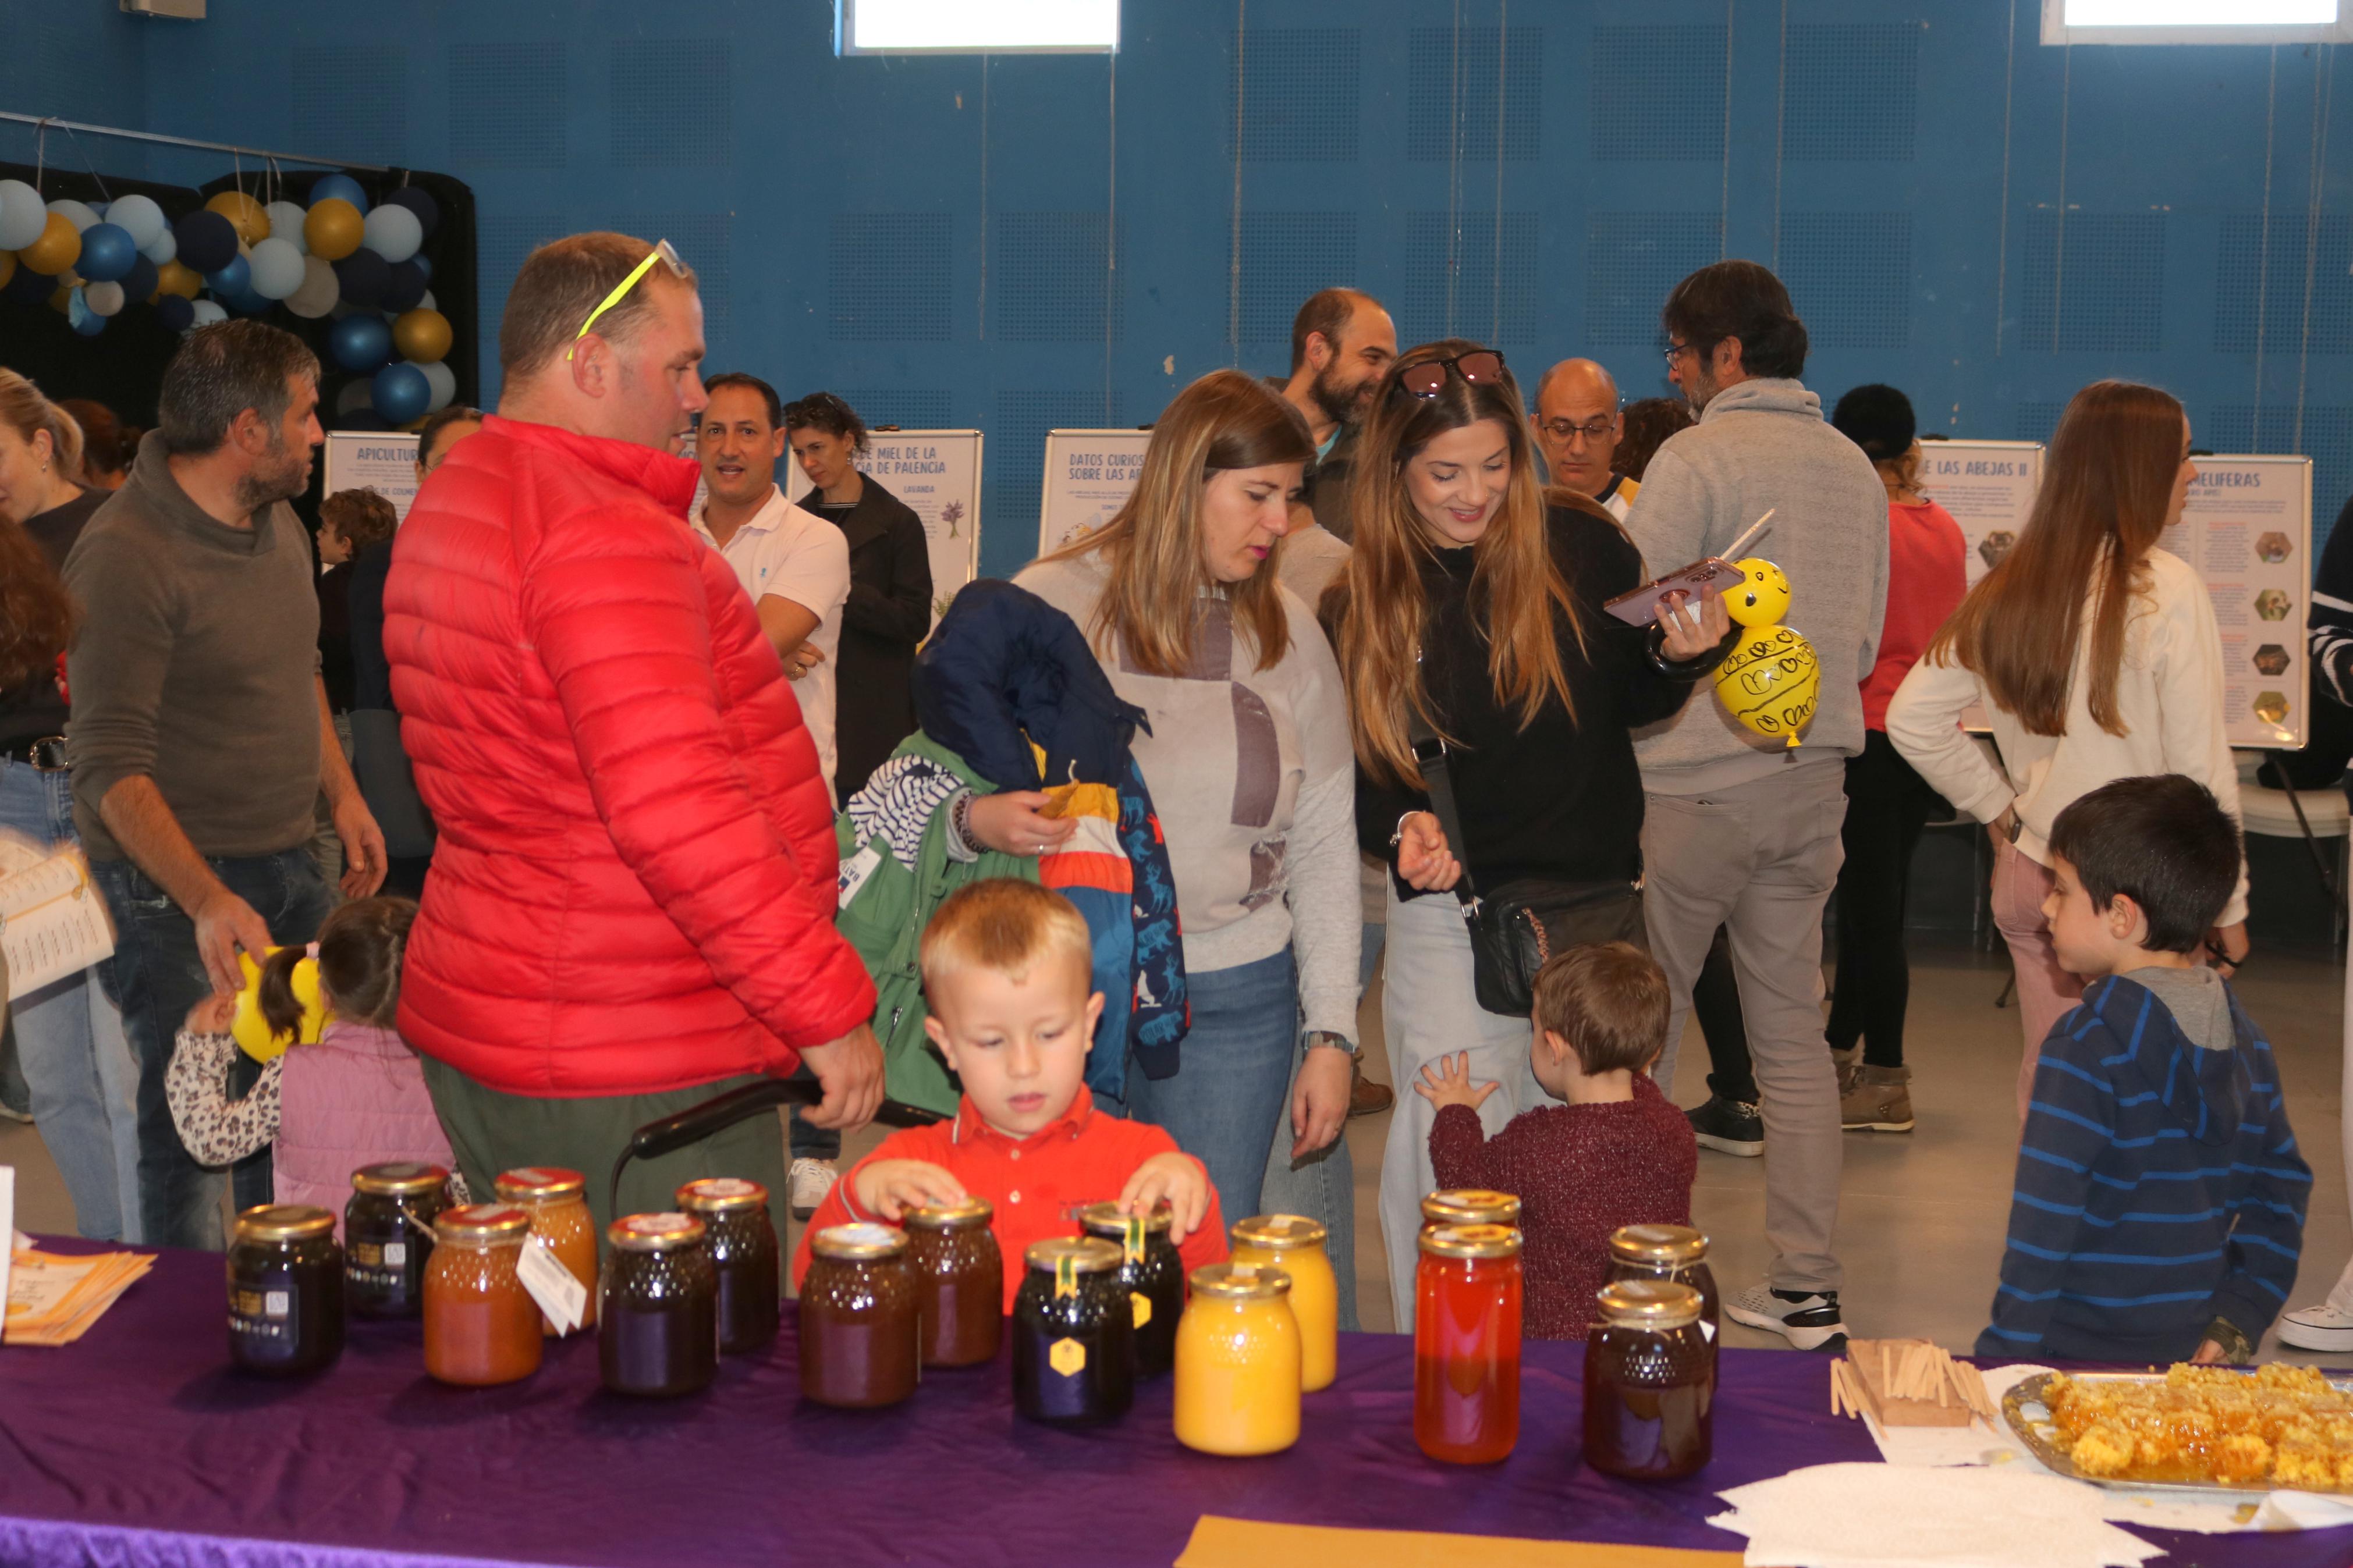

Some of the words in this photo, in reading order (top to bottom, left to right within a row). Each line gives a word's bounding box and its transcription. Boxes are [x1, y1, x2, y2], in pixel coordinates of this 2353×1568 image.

[357, 447, 418, 461] APICULTUR
[906, 447, 918, 459] DE
[924, 447, 936, 459] LA
[1070, 454, 1103, 465] DATOS
[878, 462, 889, 474] DE
[1069, 468, 1101, 480] SOBRE
[1106, 468, 1124, 480] LAS
[1937, 461, 1960, 475] LAS
[1965, 461, 2013, 476] ABEJAS
